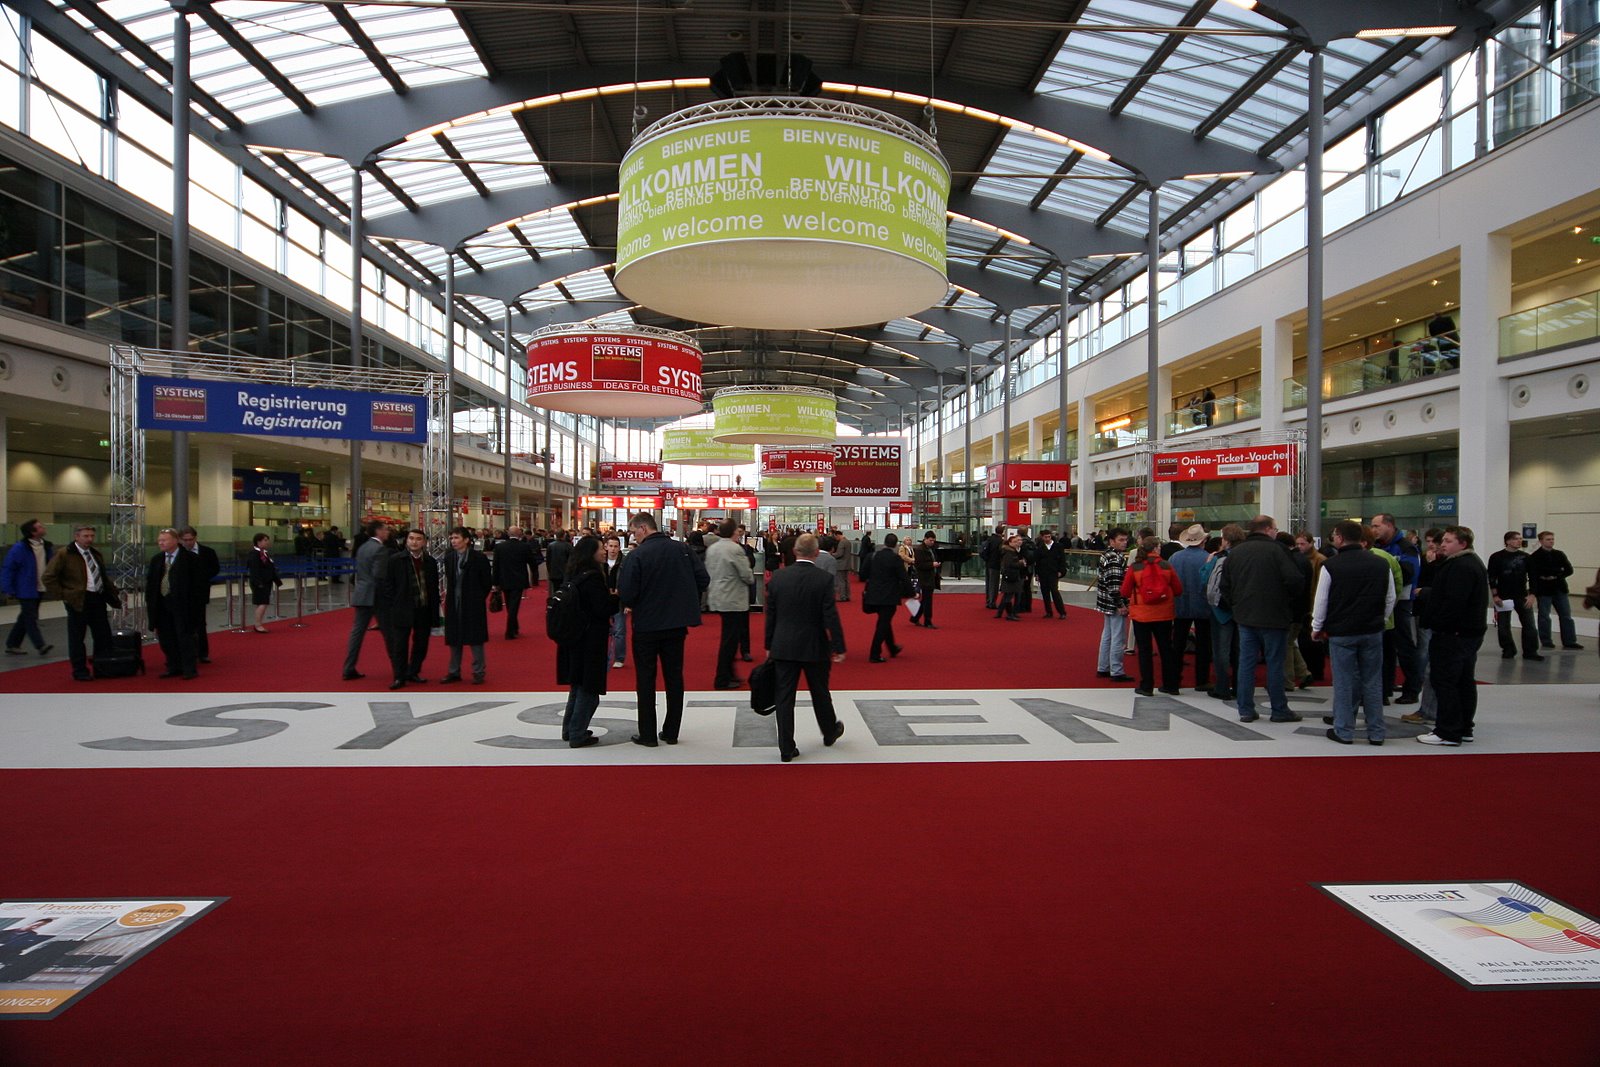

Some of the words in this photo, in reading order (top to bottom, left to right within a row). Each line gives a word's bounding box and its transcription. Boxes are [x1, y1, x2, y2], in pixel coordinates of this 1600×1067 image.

[662, 129, 751, 159] BIENVENUE
[783, 128, 881, 155] BIENVENUE
[665, 177, 763, 206] BENVENUTO
[790, 177, 891, 204] BENVENUTO
[648, 192, 714, 219] bienvenido
[723, 185, 810, 201] bienvenido
[820, 187, 896, 214] bienvenido
[662, 214, 764, 242] welcome
[783, 211, 889, 241] welcome
[594, 346, 642, 357] SYSTEMS
[657, 342, 679, 351] SYSTEMS
[554, 382, 593, 390] BUSINESS
[632, 384, 650, 392] FOR
[652, 385, 680, 396] BETTER
[155, 387, 205, 398] SYSTEMS
[238, 391, 347, 416] Registrierung
[373, 402, 414, 412] SYSTEMS
[242, 411, 342, 430] Registration
[834, 446, 900, 459] SYSTEMS
[793, 460, 832, 470] SYSTEMS
[616, 470, 655, 480] SYSTEMS
[255, 486, 273, 496] Cash
[274, 488, 291, 497] Desk
[78, 695, 1424, 751] SYSTEMS
